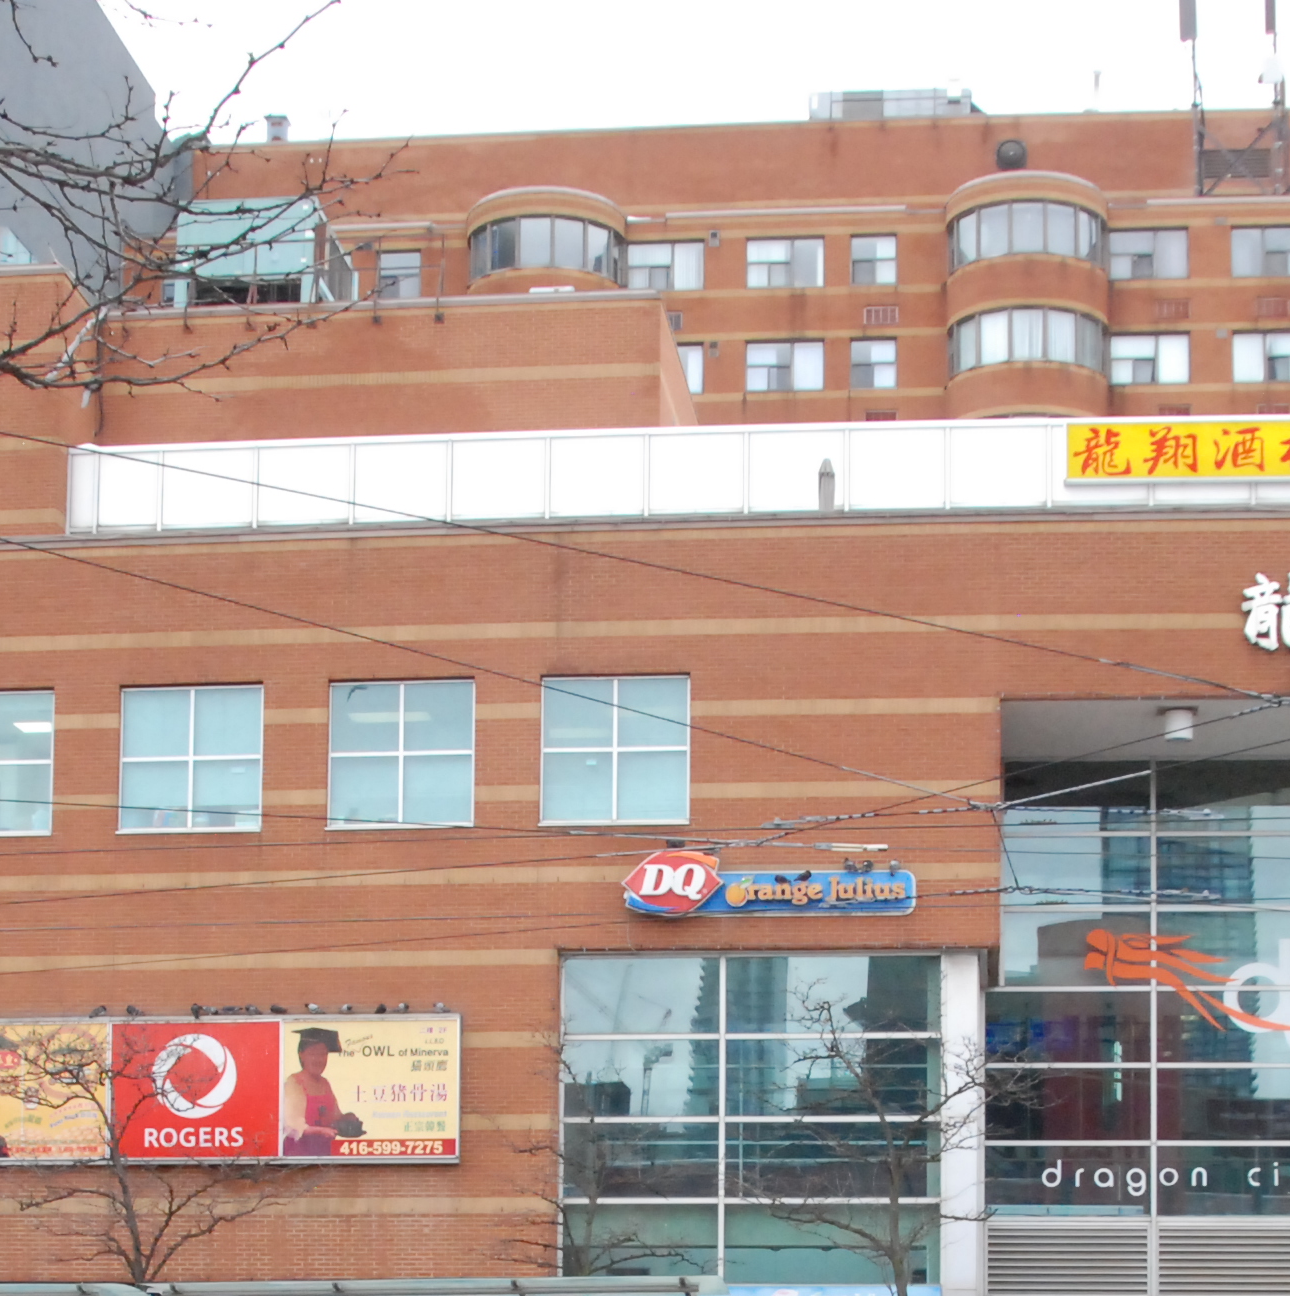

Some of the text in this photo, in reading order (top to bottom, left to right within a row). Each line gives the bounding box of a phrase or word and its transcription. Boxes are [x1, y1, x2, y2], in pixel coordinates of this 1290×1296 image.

[639, 863, 707, 900] DQ
[827, 876, 907, 901] Julius
[362, 1045, 395, 1057] OWL
[398, 1047, 408, 1057] of
[410, 1048, 449, 1057] Minerva
[144, 1127, 244, 1148] ROGERS
[340, 1140, 444, 1155] 416-599-7275
[1041, 1159, 1209, 1196] dragon
